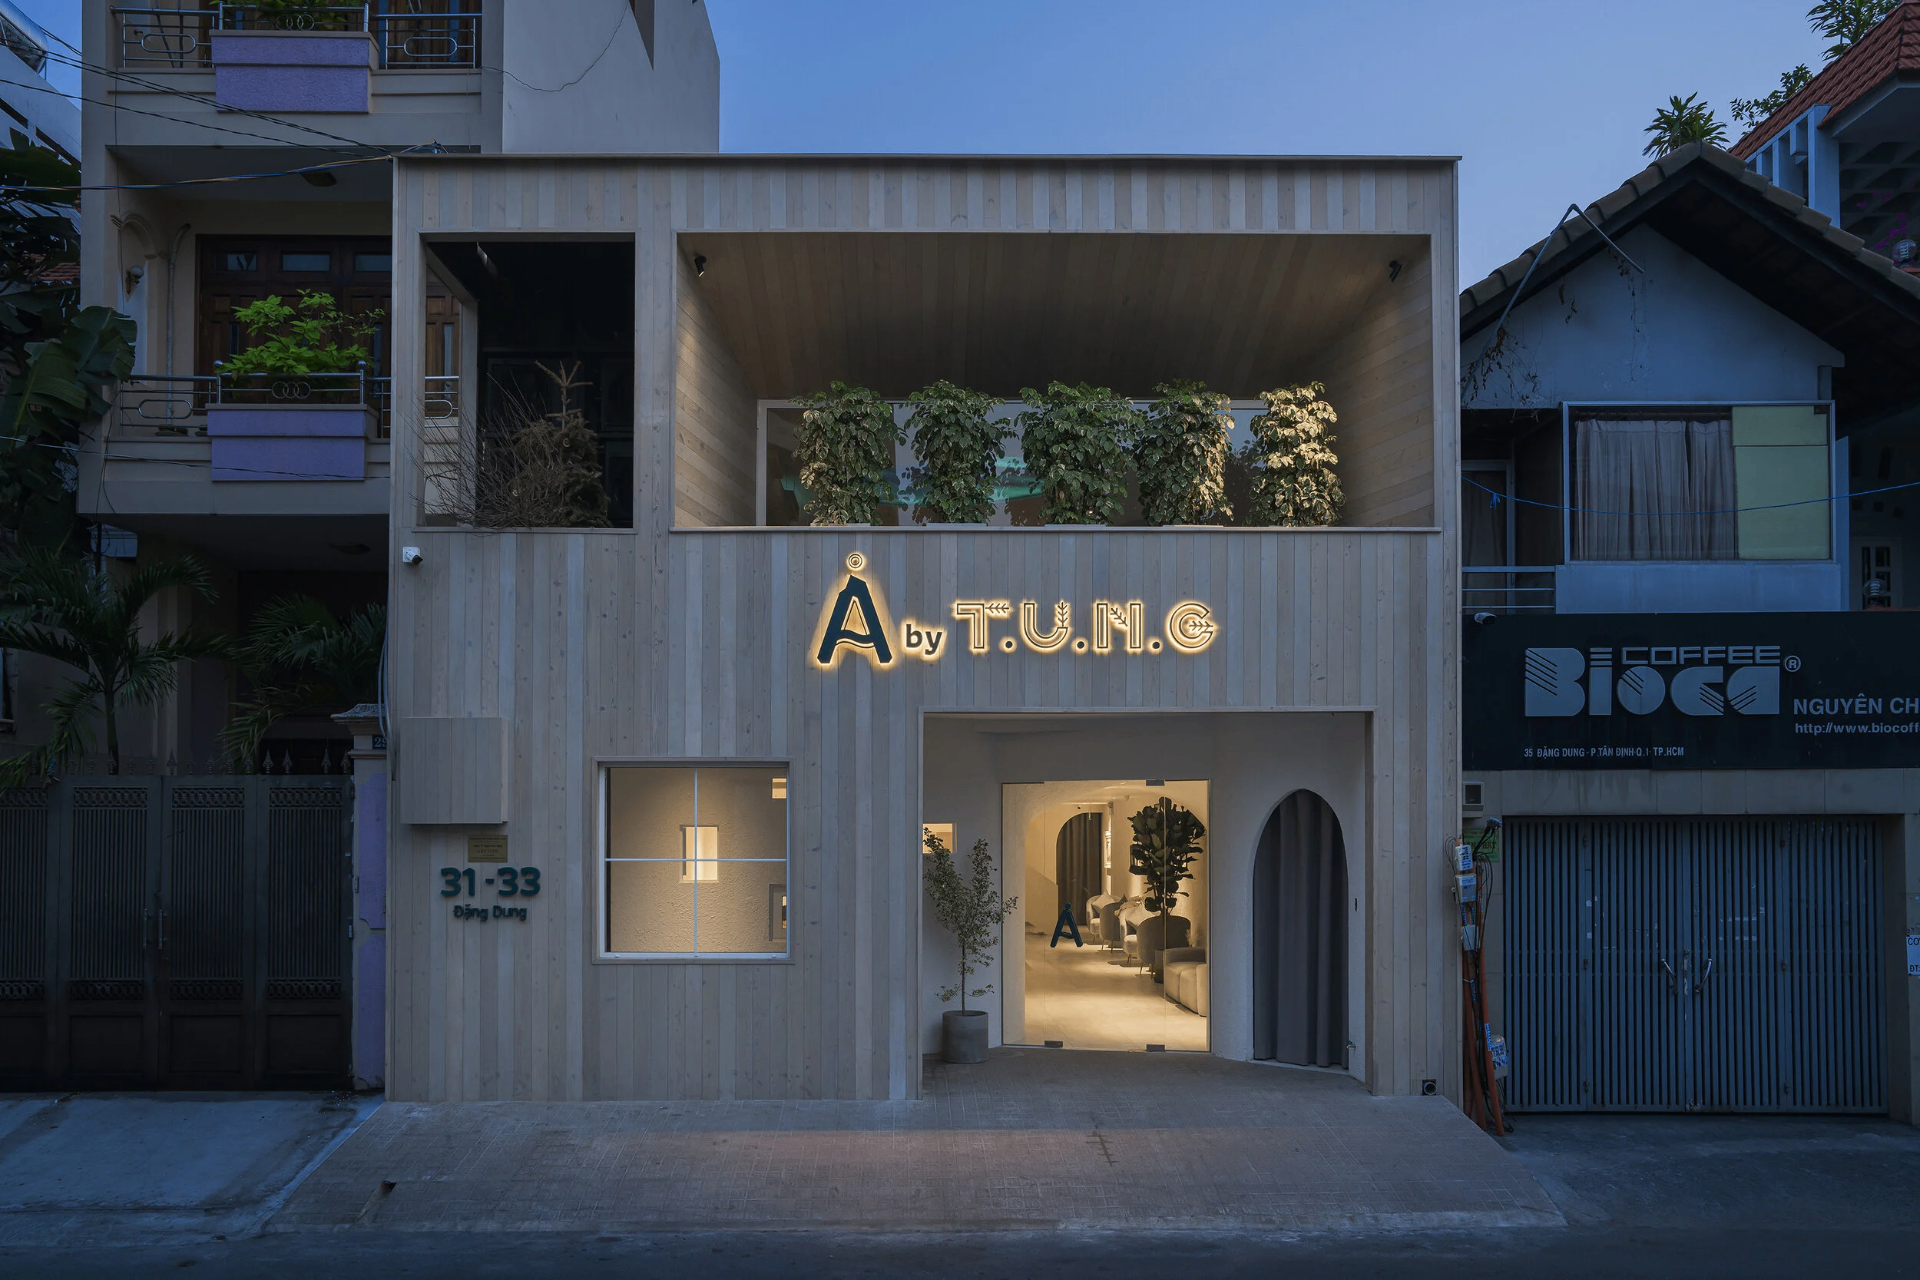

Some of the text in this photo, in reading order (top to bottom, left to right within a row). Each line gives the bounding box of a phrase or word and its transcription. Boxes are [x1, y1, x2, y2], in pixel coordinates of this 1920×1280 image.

[905, 623, 943, 655] by
[1621, 646, 1781, 665] COFFEE
[1793, 692, 1920, 715] NGUYÊN CH
[1795, 722, 1920, 736] http://www.biocoff
[1524, 748, 1533, 758] 35
[1537, 745, 1560, 759] ĐẶNG
[1562, 747, 1585, 758] DUNG
[1653, 747, 1684, 757] TP.HCM
[453, 904, 527, 921] Đặng Dung
[1908, 937, 1920, 946] CO
